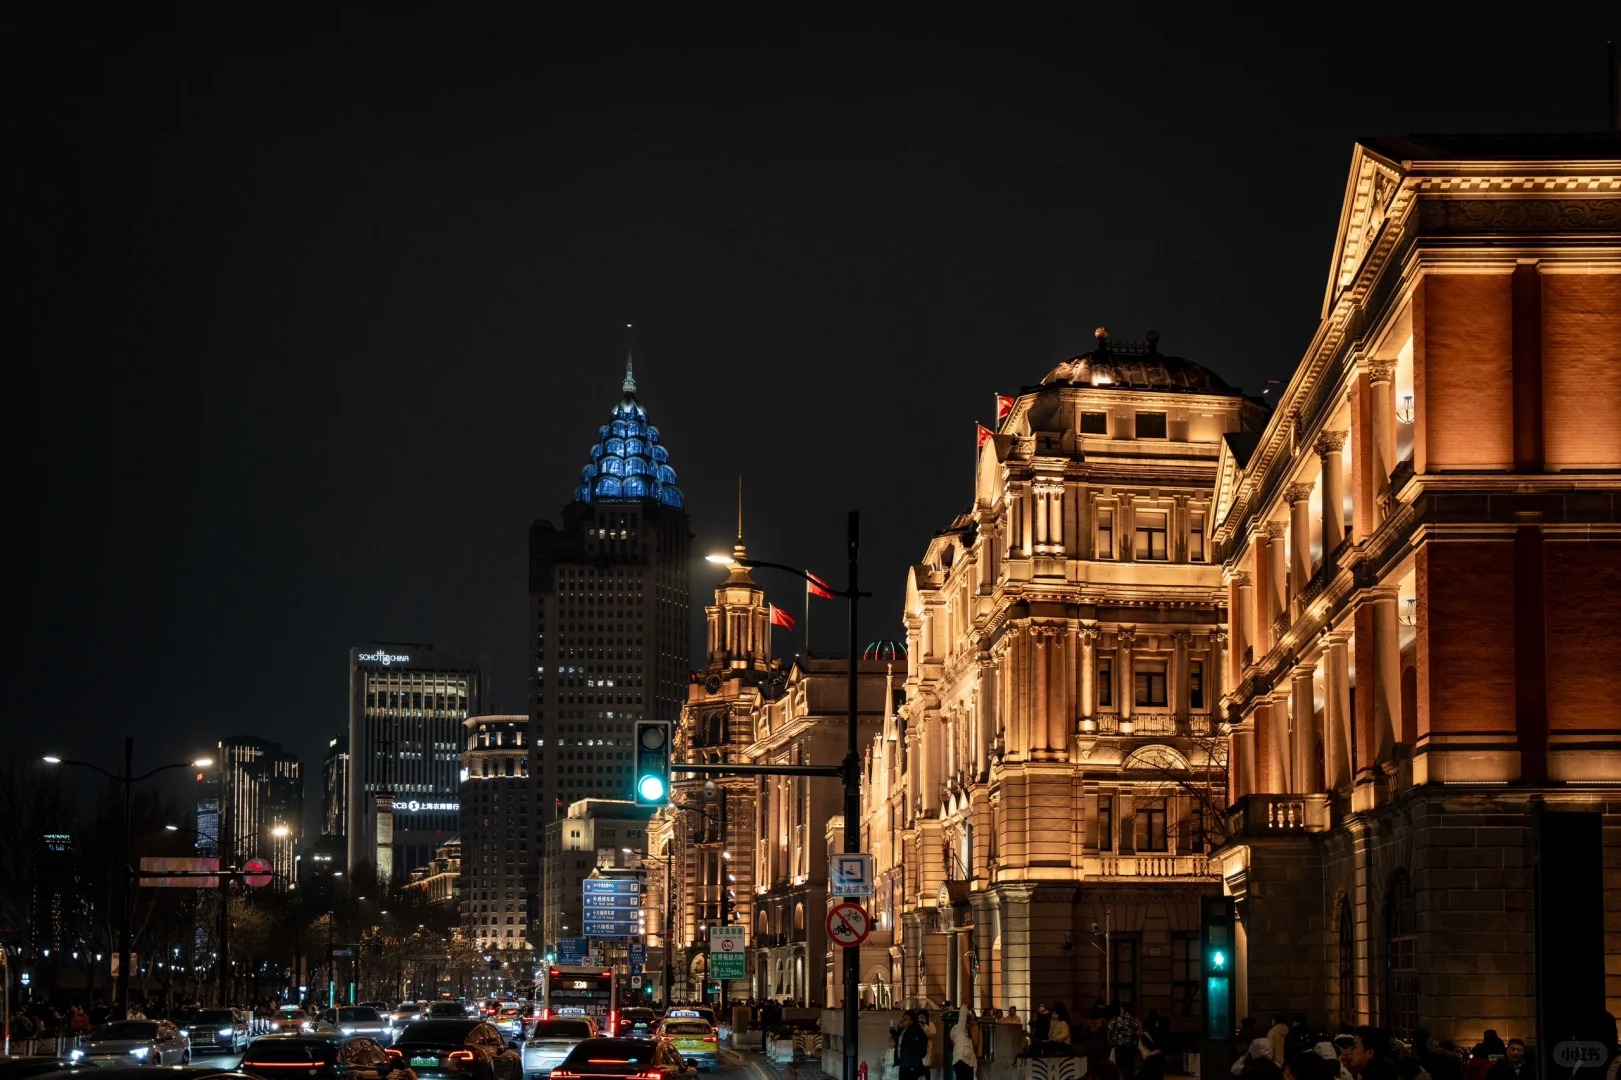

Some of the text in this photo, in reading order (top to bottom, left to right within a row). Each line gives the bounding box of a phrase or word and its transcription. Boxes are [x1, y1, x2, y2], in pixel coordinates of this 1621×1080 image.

[420, 802, 460, 810] 上海农商银行
